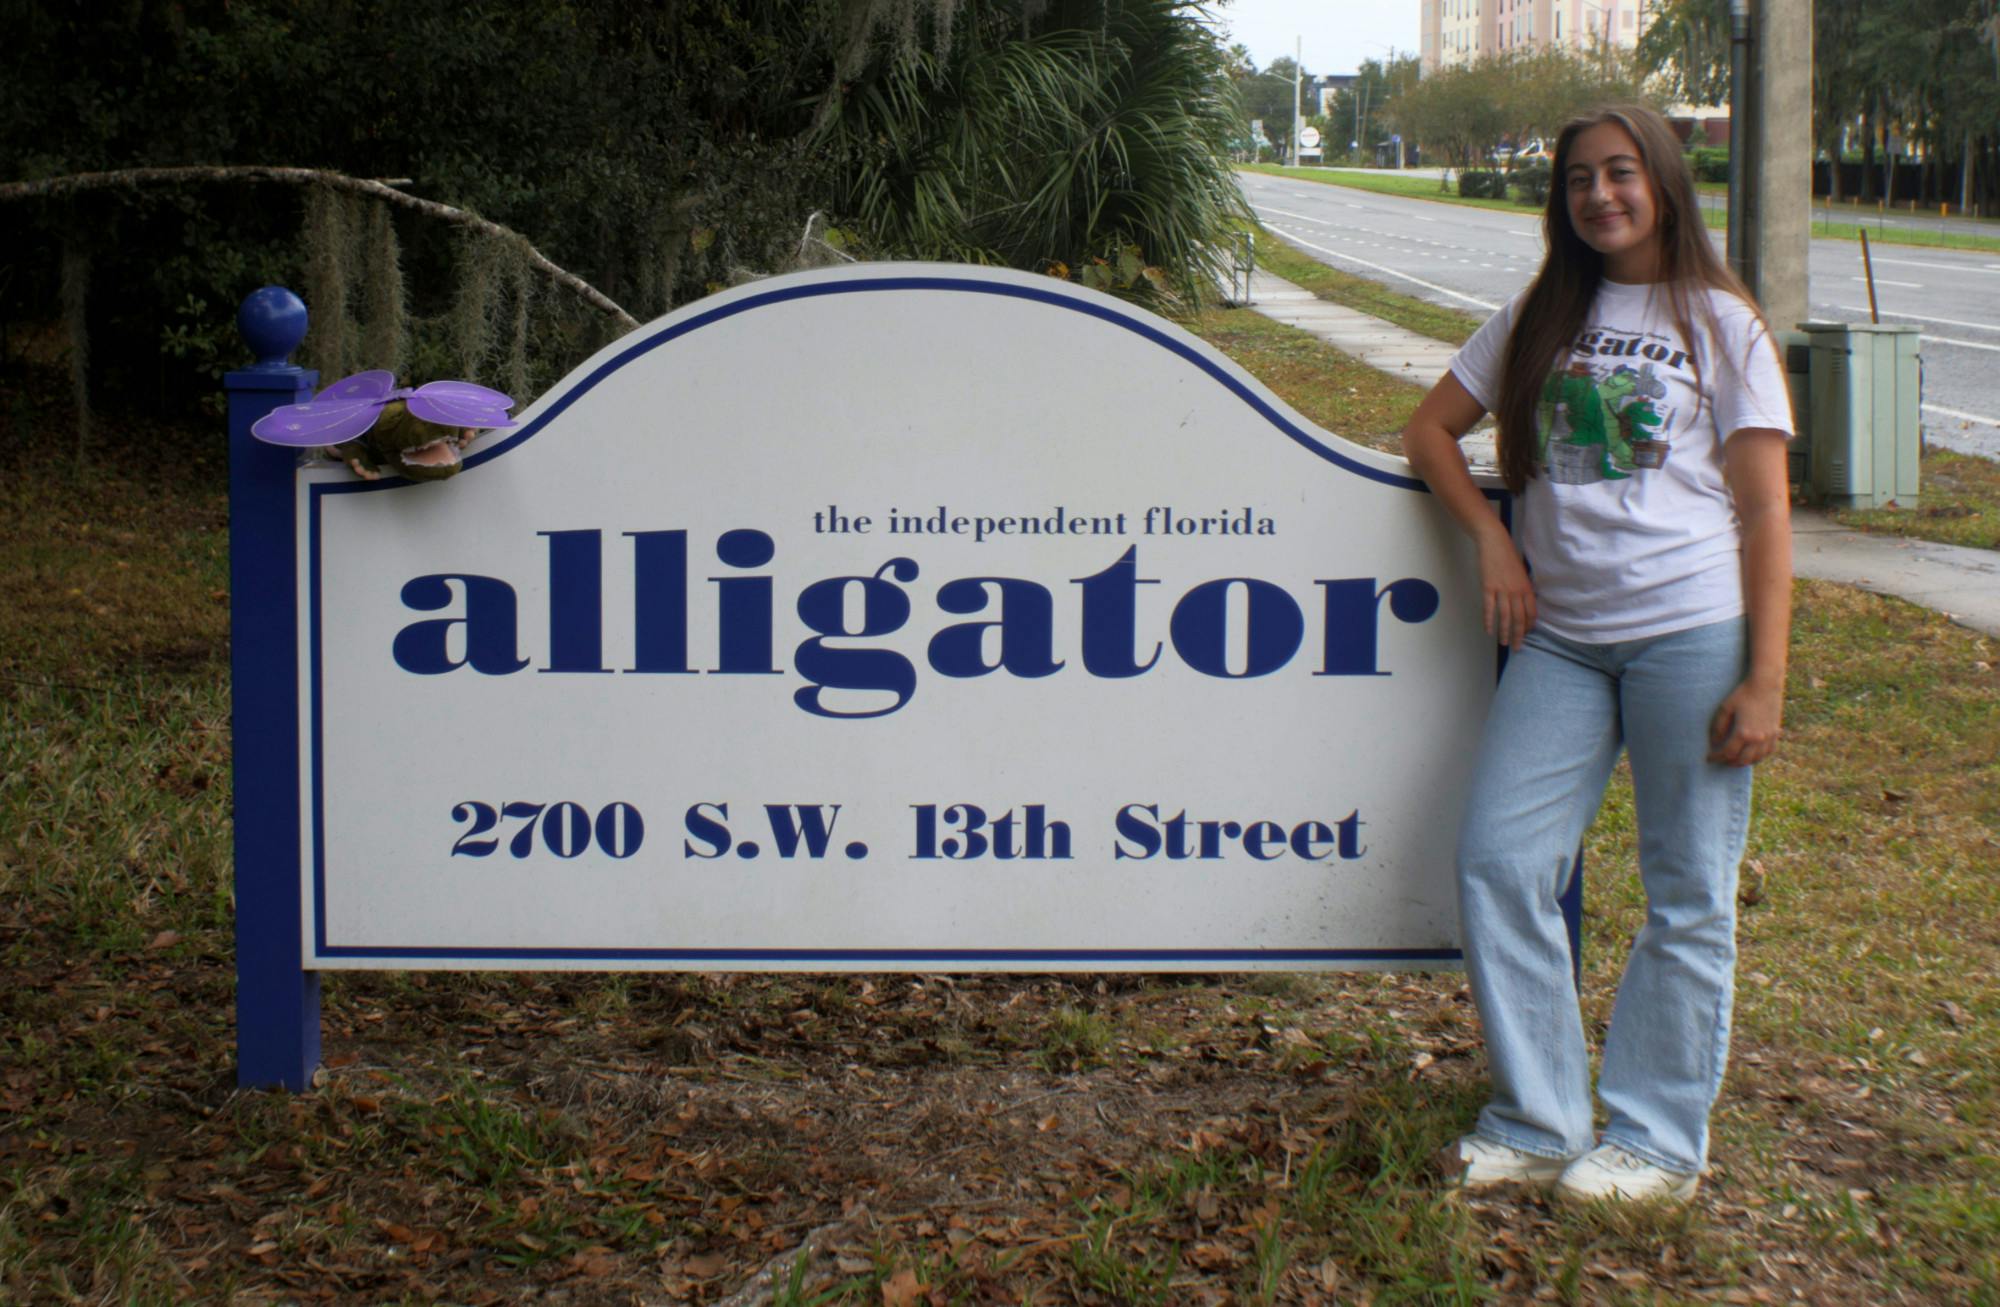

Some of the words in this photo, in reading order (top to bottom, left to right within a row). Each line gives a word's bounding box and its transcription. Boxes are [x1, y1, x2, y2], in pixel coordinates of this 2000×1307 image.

[1573, 331, 1697, 370] gator
[814, 505, 873, 534] the
[889, 506, 1126, 543] independent
[1144, 507, 1277, 536] florida
[391, 528, 1440, 720] alligator
[450, 801, 645, 860] 2700
[683, 802, 869, 860] S.W.
[908, 804, 1075, 860] 13th
[1114, 803, 1368, 861] Street
